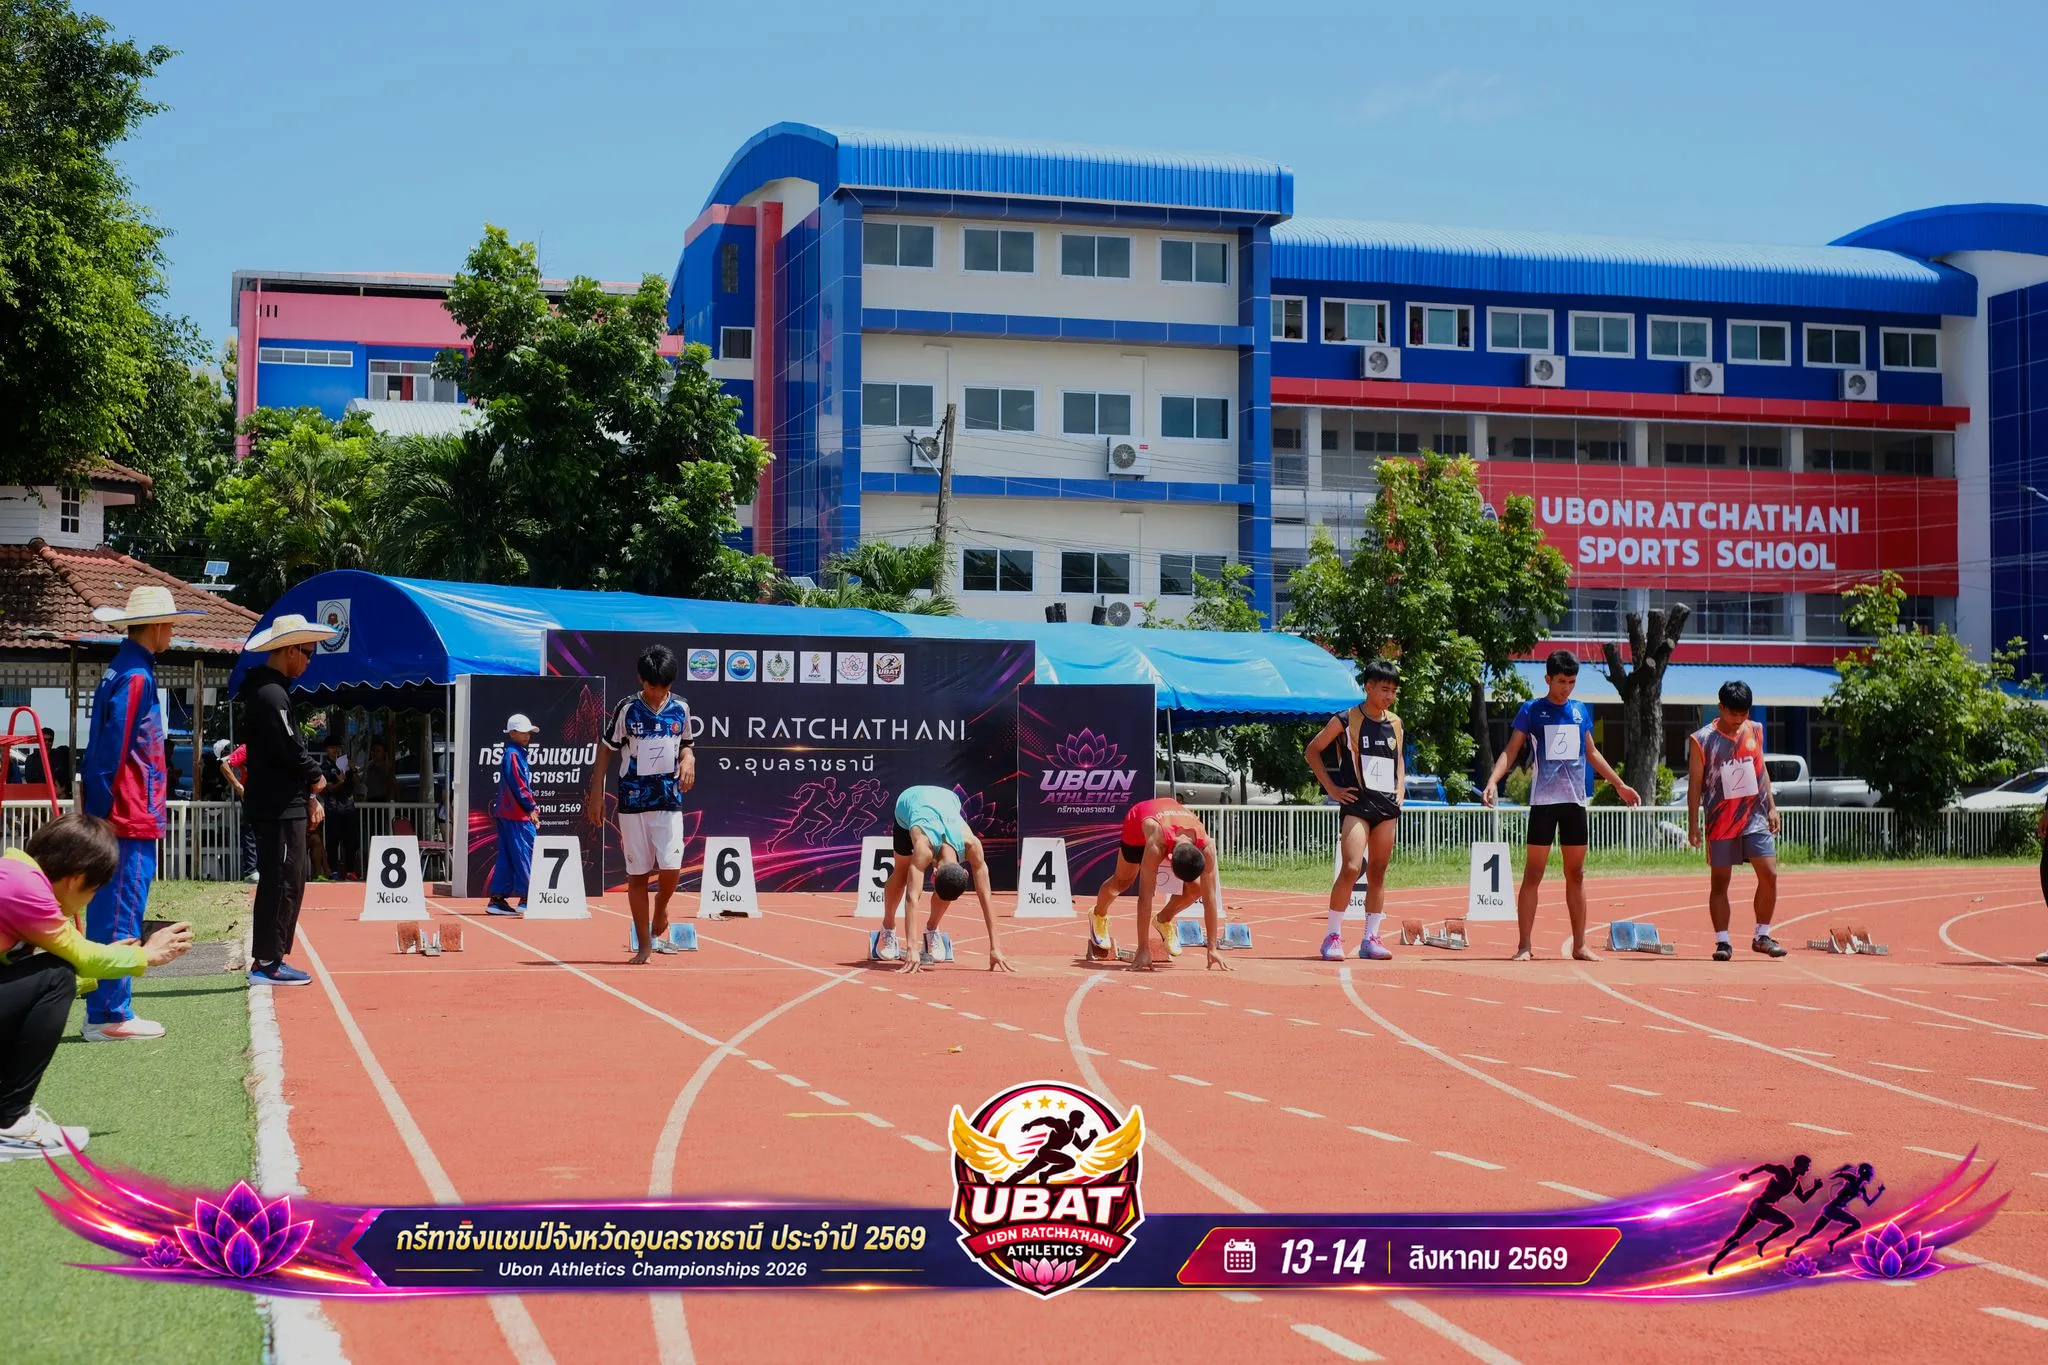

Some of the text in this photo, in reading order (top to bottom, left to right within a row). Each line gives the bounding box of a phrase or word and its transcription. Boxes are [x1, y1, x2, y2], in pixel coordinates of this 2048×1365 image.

[1541, 496, 1860, 534] UBONRATCHATHANI
[1579, 535, 1836, 571] SPORTS SCHOOL
[690, 715, 966, 741] ON RATCHATHANI
[1553, 732, 1568, 755] 3
[648, 746, 665, 768] 7
[718, 754, 874, 777] จ.อุบลราชธานี
[1040, 769, 1138, 791] UBON
[1370, 759, 1383, 784] 4
[1731, 767, 1745, 791] 2
[559, 803, 581, 813] 2569
[1041, 791, 1133, 804] ATHLETICS
[380, 847, 407, 889] 8
[543, 848, 570, 890] 7
[716, 847, 741, 888] 6
[872, 848, 896, 889] 5
[1031, 850, 1056, 891] 4
[1483, 854, 1500, 893] 1
[376, 891, 408, 904] Nelco
[539, 891, 570, 904] Nelco
[711, 890, 742, 902] Nelco
[868, 890, 885, 903] Nel
[1028, 892, 1057, 905] Nelco
[1476, 894, 1504, 906] Nelco
